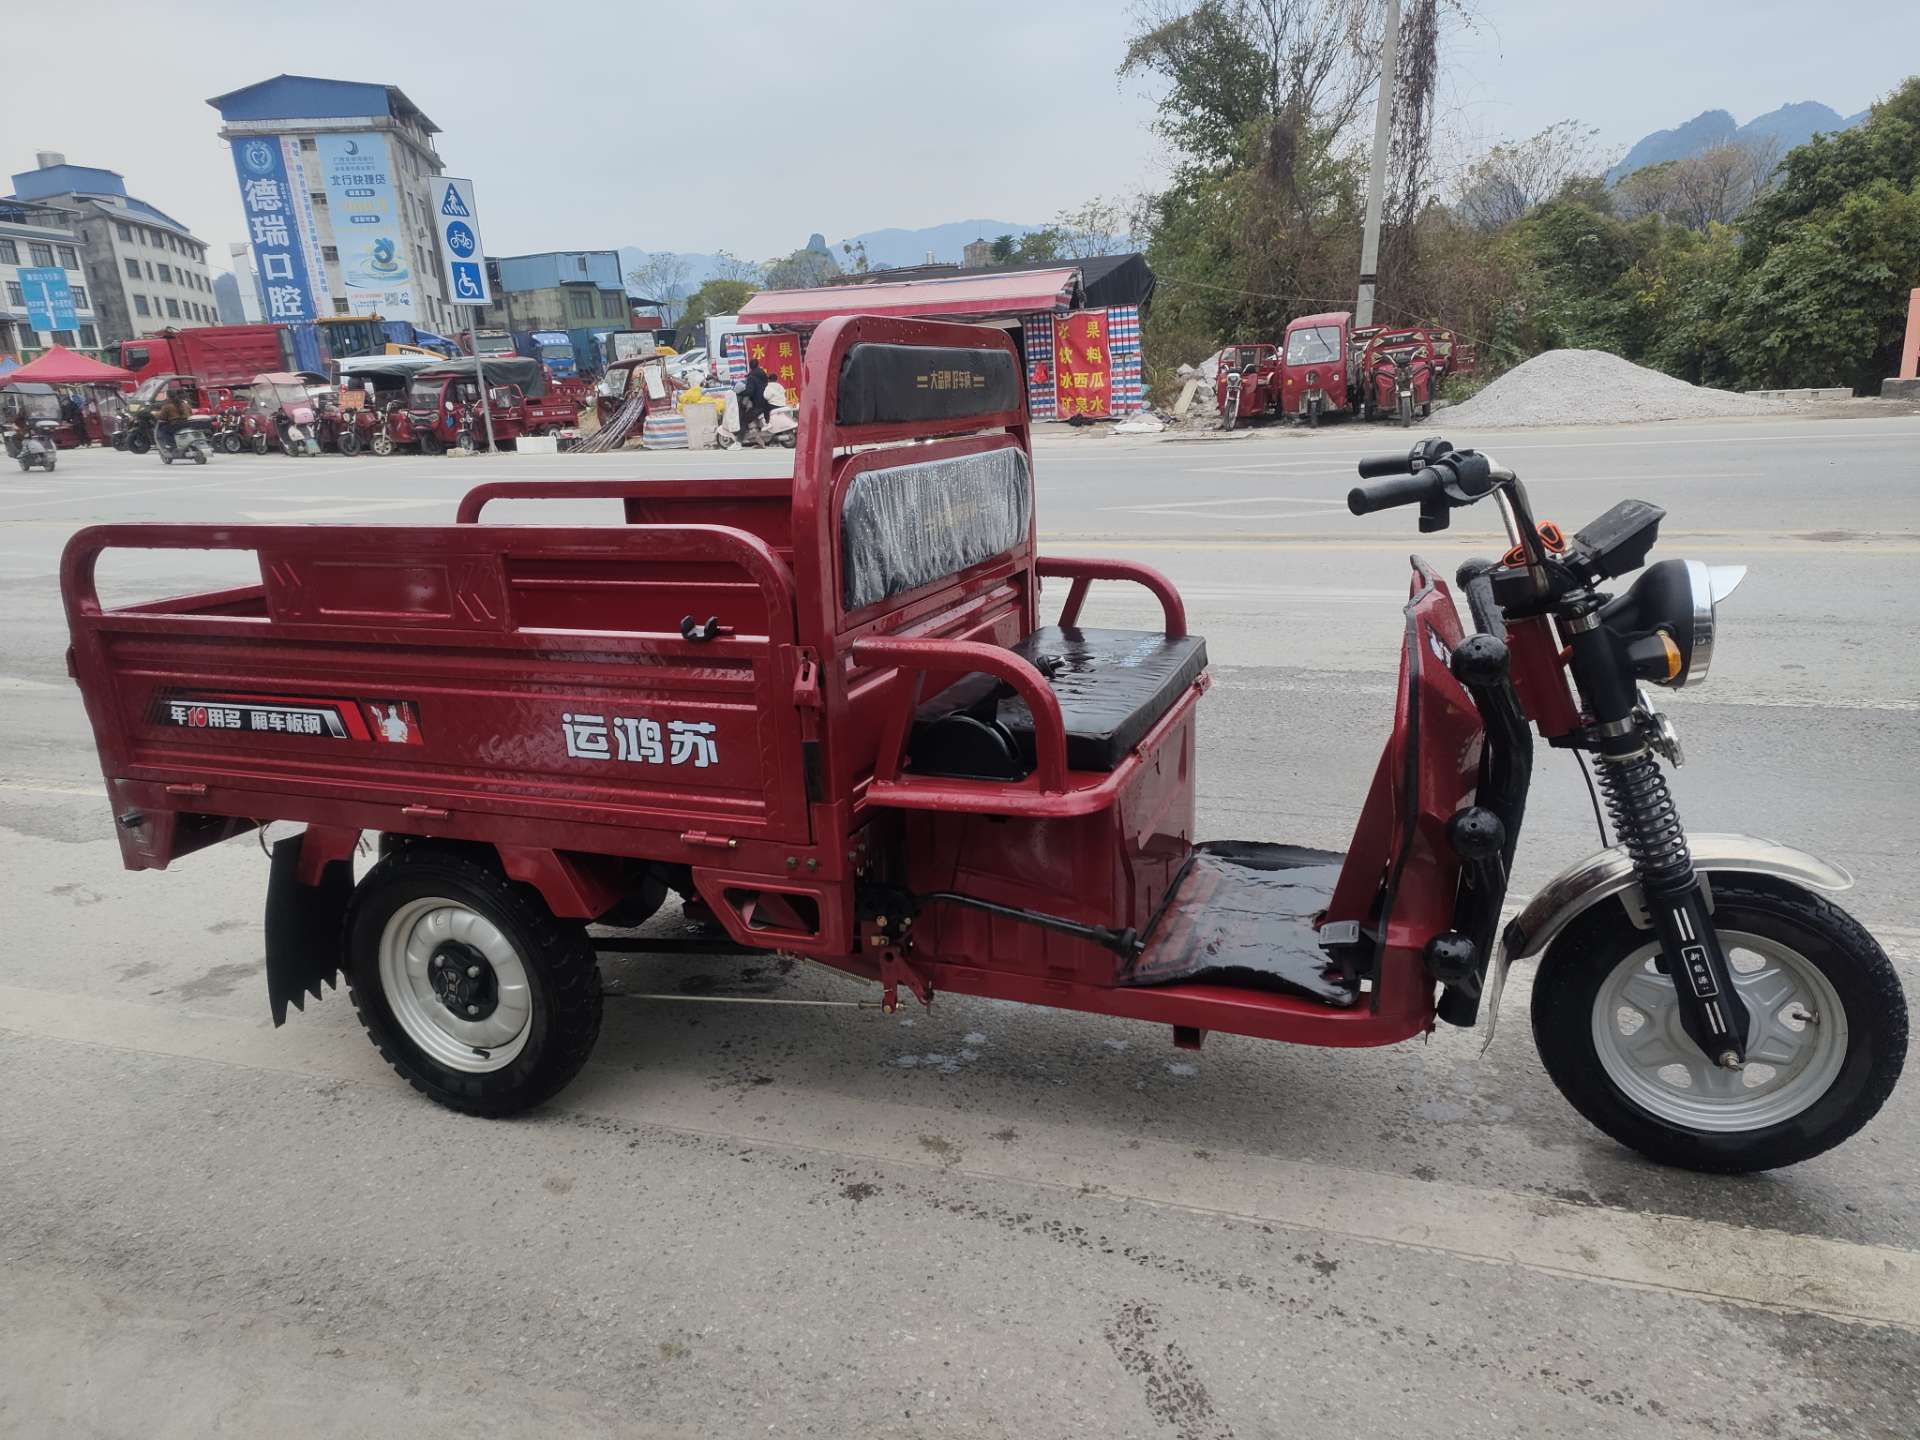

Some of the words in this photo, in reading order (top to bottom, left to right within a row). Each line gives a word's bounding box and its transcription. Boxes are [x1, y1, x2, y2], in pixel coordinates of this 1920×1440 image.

[244, 178, 304, 318] 德瑞口腔
[1057, 320, 1101, 340] 水果
[752, 342, 793, 360] 水果
[1058, 346, 1104, 365] 饮料
[1059, 371, 1105, 389] 冰西瓜
[1060, 396, 1105, 414] 矿泉水
